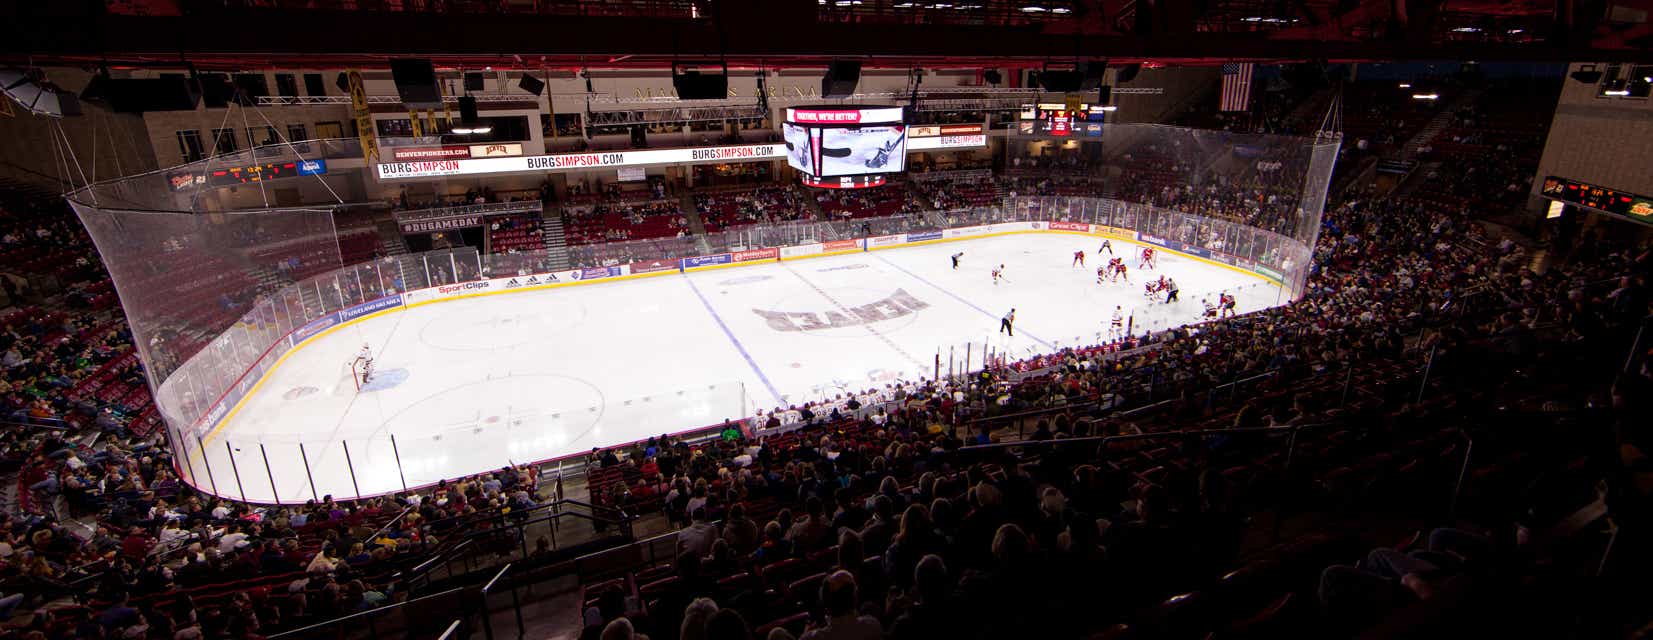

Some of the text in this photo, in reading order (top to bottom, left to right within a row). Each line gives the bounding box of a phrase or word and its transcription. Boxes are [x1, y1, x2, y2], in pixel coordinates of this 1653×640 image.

[396, 149, 469, 158] DENVERPIONEERS.COM
[485, 145, 508, 155] DENVER
[692, 147, 774, 160] BURGSIMPSON.COM
[382, 160, 459, 174] BURGSIMPSON
[527, 154, 624, 168] BURGSIMPSON.COM
[404, 217, 478, 232] #DUGAMEDAY
